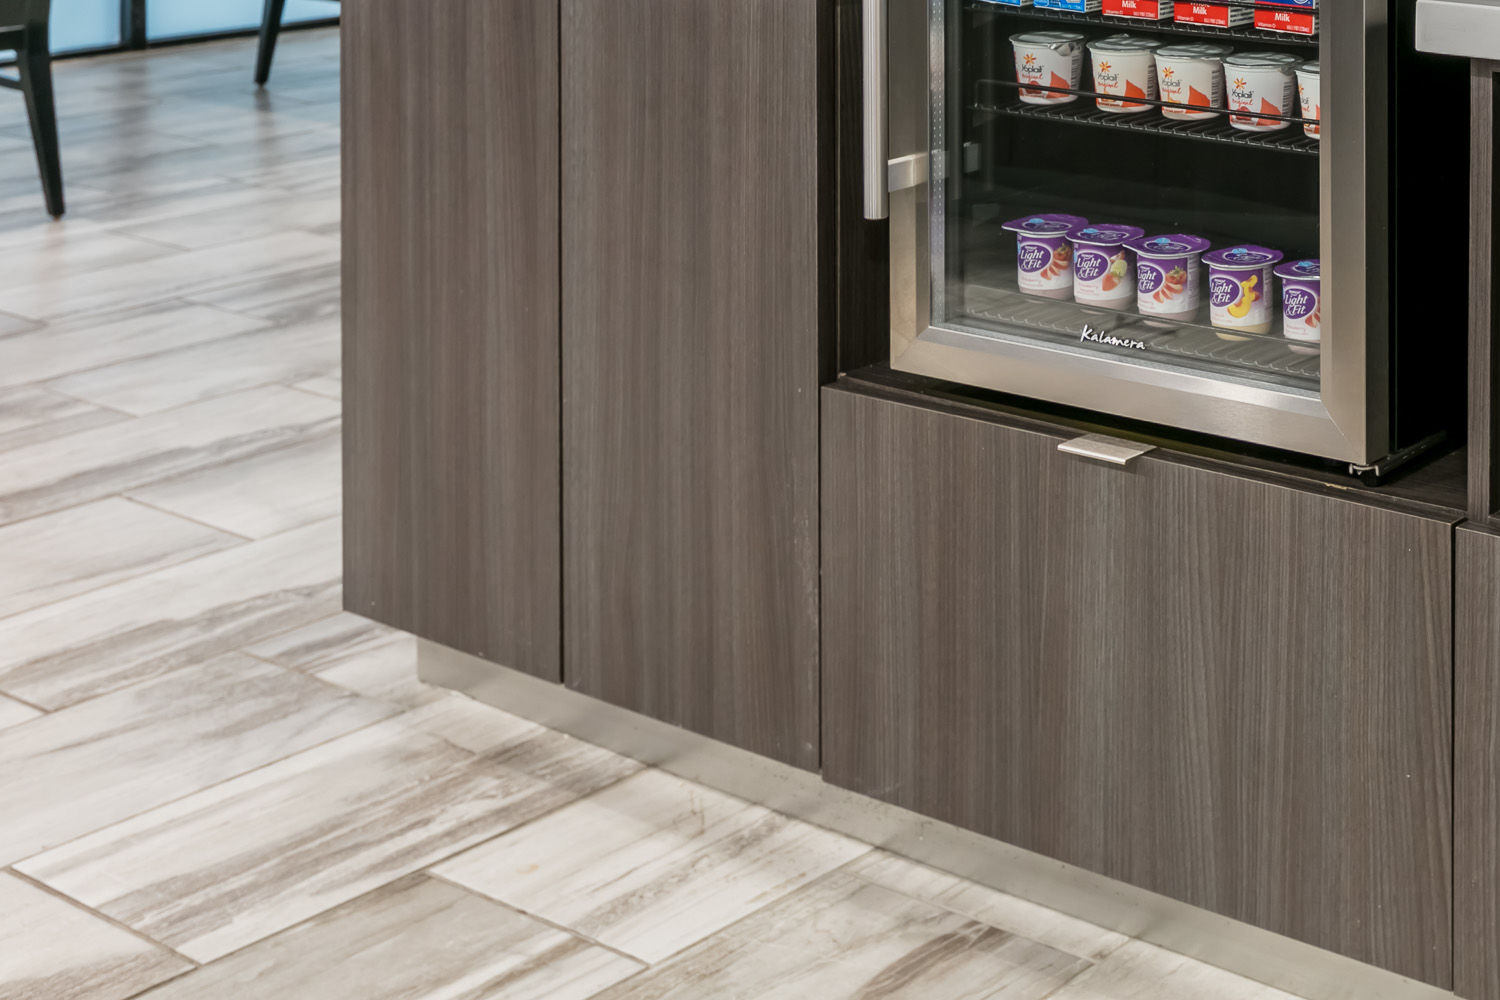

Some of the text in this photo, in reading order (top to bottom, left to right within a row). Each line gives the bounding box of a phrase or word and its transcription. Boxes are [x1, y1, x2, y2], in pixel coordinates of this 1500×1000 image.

[1193, 7, 1207, 15] Milk
[1275, 13, 1290, 22] Milk
[1021, 249, 1044, 261] Light
[1077, 258, 1101, 269] Light
[1211, 283, 1233, 295] Light
[1285, 294, 1308, 306] Light
[1080, 324, 1146, 351] Kalamera
